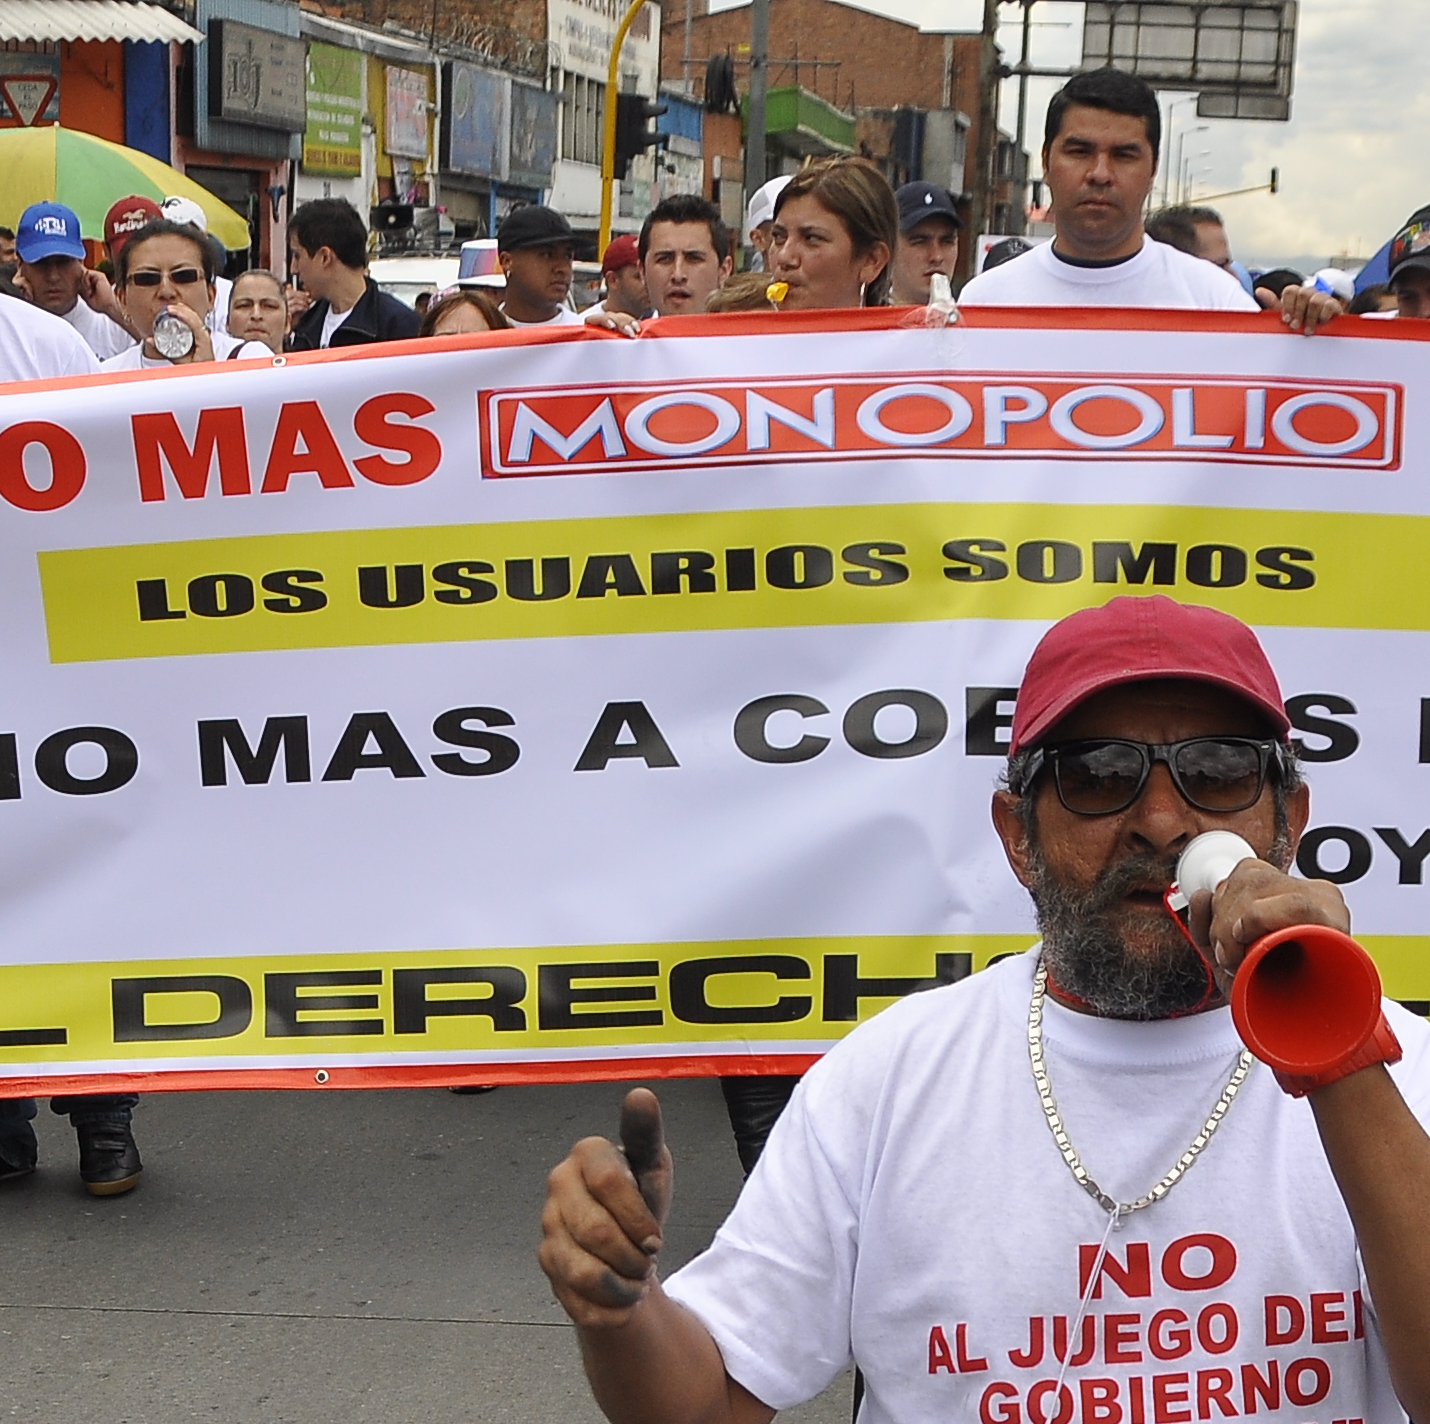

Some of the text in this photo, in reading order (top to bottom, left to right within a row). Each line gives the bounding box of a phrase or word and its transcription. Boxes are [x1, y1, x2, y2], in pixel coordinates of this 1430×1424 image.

[132, 392, 443, 502] MAS
[506, 383, 1379, 460] MONOPOLIO
[136, 569, 328, 621] LOS
[357, 541, 909, 610] USUARIOS
[942, 538, 1316, 590] SOMOS
[197, 705, 521, 787] MAS
[574, 700, 679, 770] A
[733, 687, 1360, 764] COS
[111, 952, 1026, 1043] DERECH
[1078, 1233, 1237, 1300] NO
[928, 1323, 987, 1374] AL
[1008, 1303, 1238, 1368] JUEGO
